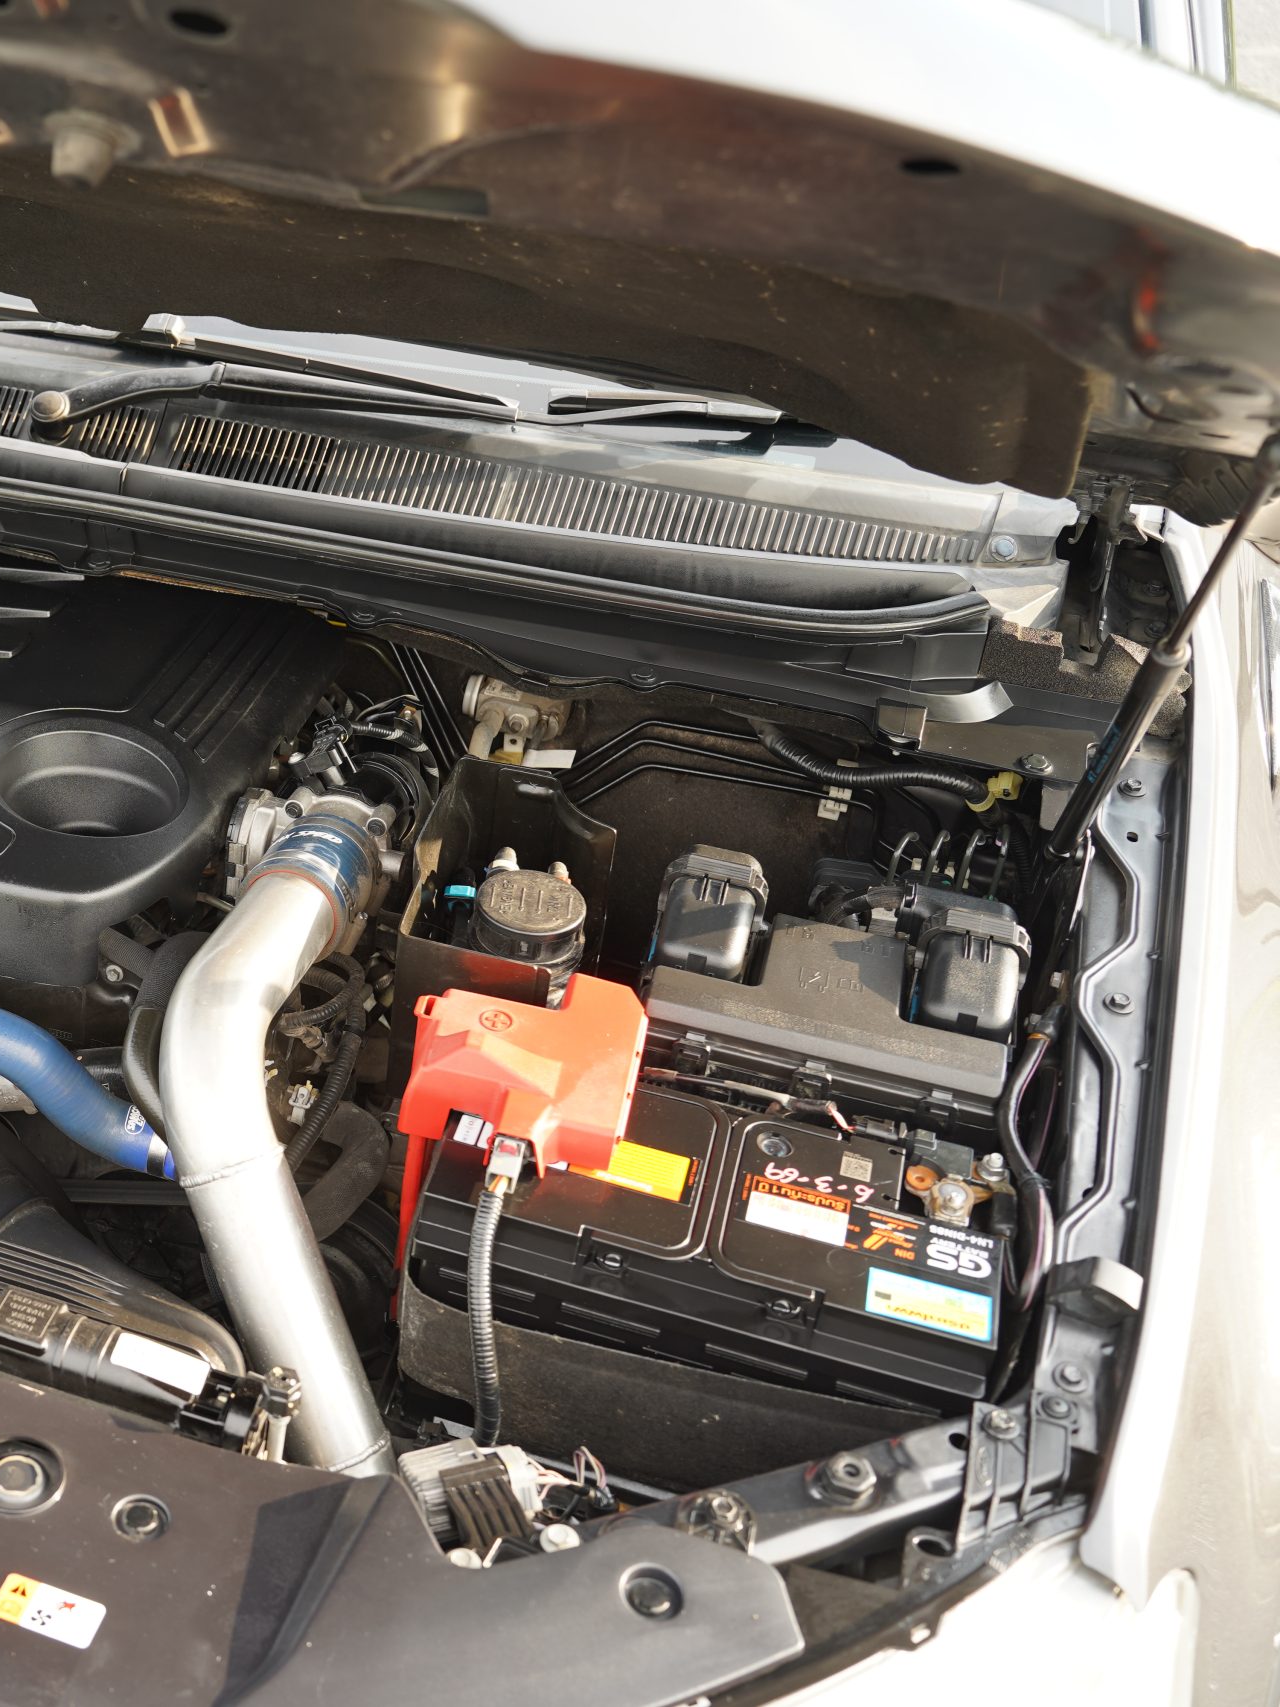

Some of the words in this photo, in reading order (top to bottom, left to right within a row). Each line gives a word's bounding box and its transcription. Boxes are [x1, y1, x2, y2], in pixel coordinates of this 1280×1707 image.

[894, 1247, 916, 1261] DIN
[930, 1237, 990, 1259] BATTERY
[926, 1243, 992, 1279] GS
